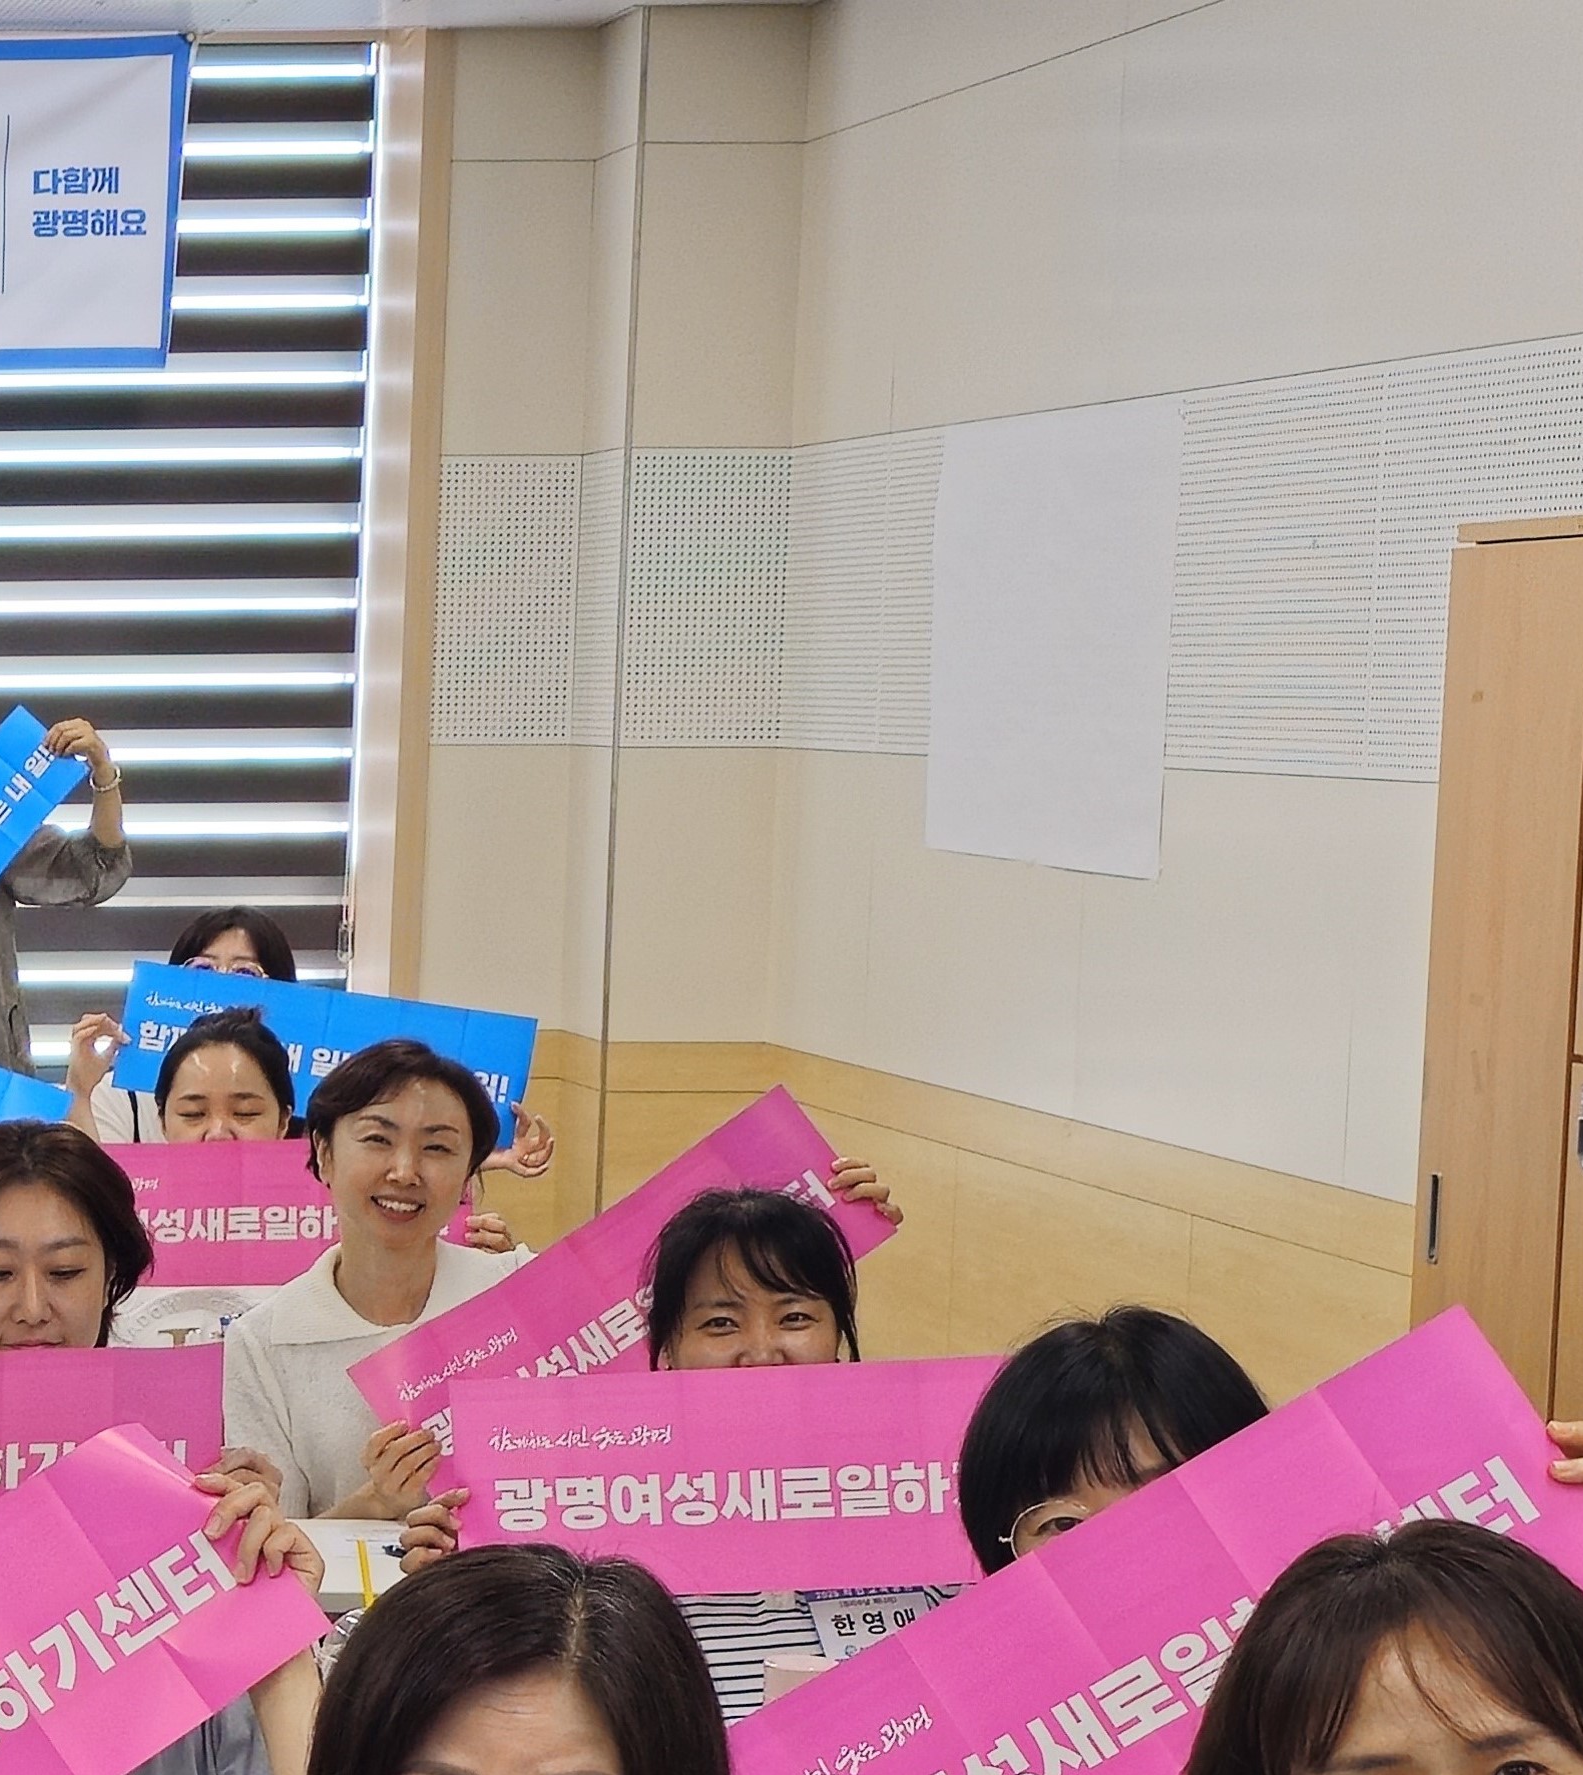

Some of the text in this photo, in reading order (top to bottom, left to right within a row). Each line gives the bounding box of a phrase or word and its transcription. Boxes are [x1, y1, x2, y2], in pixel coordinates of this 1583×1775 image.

[34, 167, 119, 194] 다함께
[33, 209, 146, 237] 광명해요
[494, 1461, 956, 1531] 광명여성새로일하
